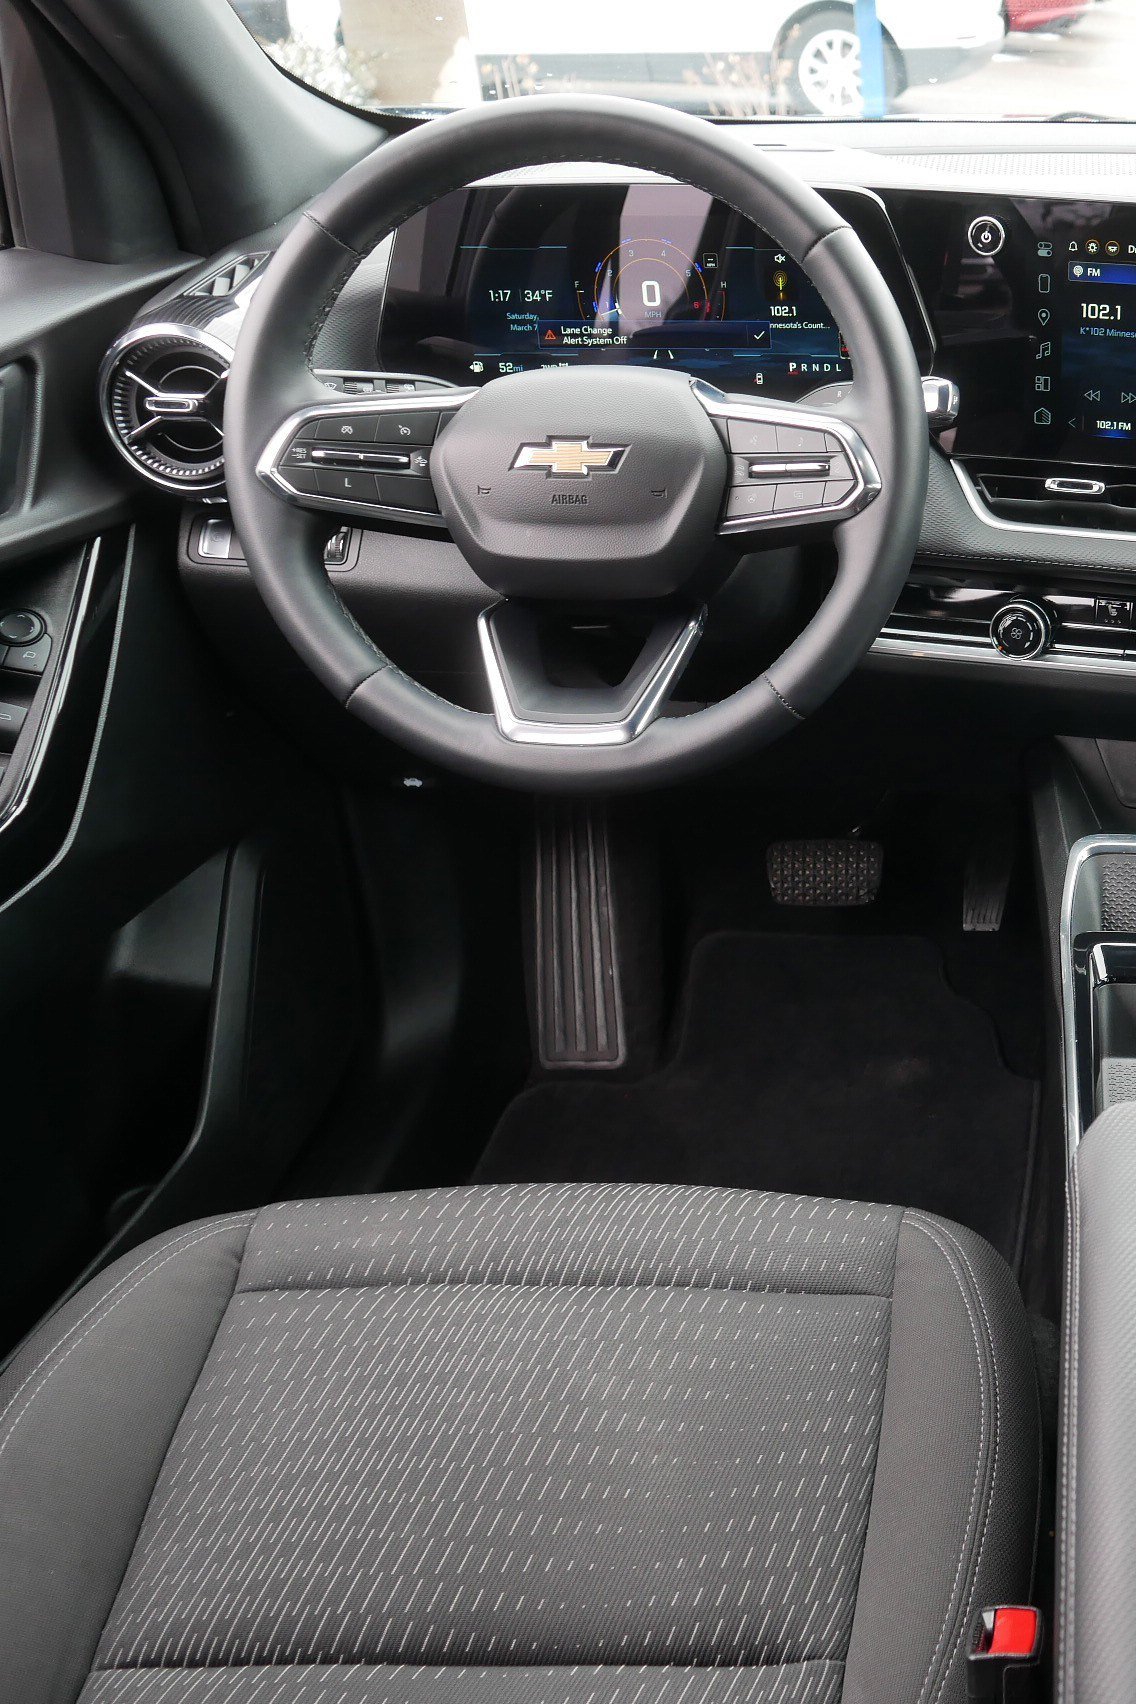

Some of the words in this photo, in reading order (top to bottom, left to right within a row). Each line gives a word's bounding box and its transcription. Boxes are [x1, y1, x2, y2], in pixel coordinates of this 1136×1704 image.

[1087, 267, 1101, 277] FM
[489, 289, 511, 302] 1:17
[524, 289, 553, 302] 34°F
[641, 280, 661, 307] 0
[769, 305, 797, 317] 102.1
[1080, 302, 1121, 320] 102.1
[510, 323, 530, 331] March
[531, 323, 538, 331] 7
[561, 325, 580, 334] Lane
[582, 325, 613, 338] Change
[563, 336, 582, 345] Alert
[583, 337, 613, 347] System
[614, 337, 628, 345] Off
[789, 362, 797, 372] P
[801, 363, 808, 371] R
[812, 363, 819, 371] N
[823, 363, 831, 371] D
[836, 363, 842, 371] L
[1096, 420, 1117, 430] 102.1
[1118, 421, 1132, 431] FM
[551, 494, 588, 505] AIRBAG
